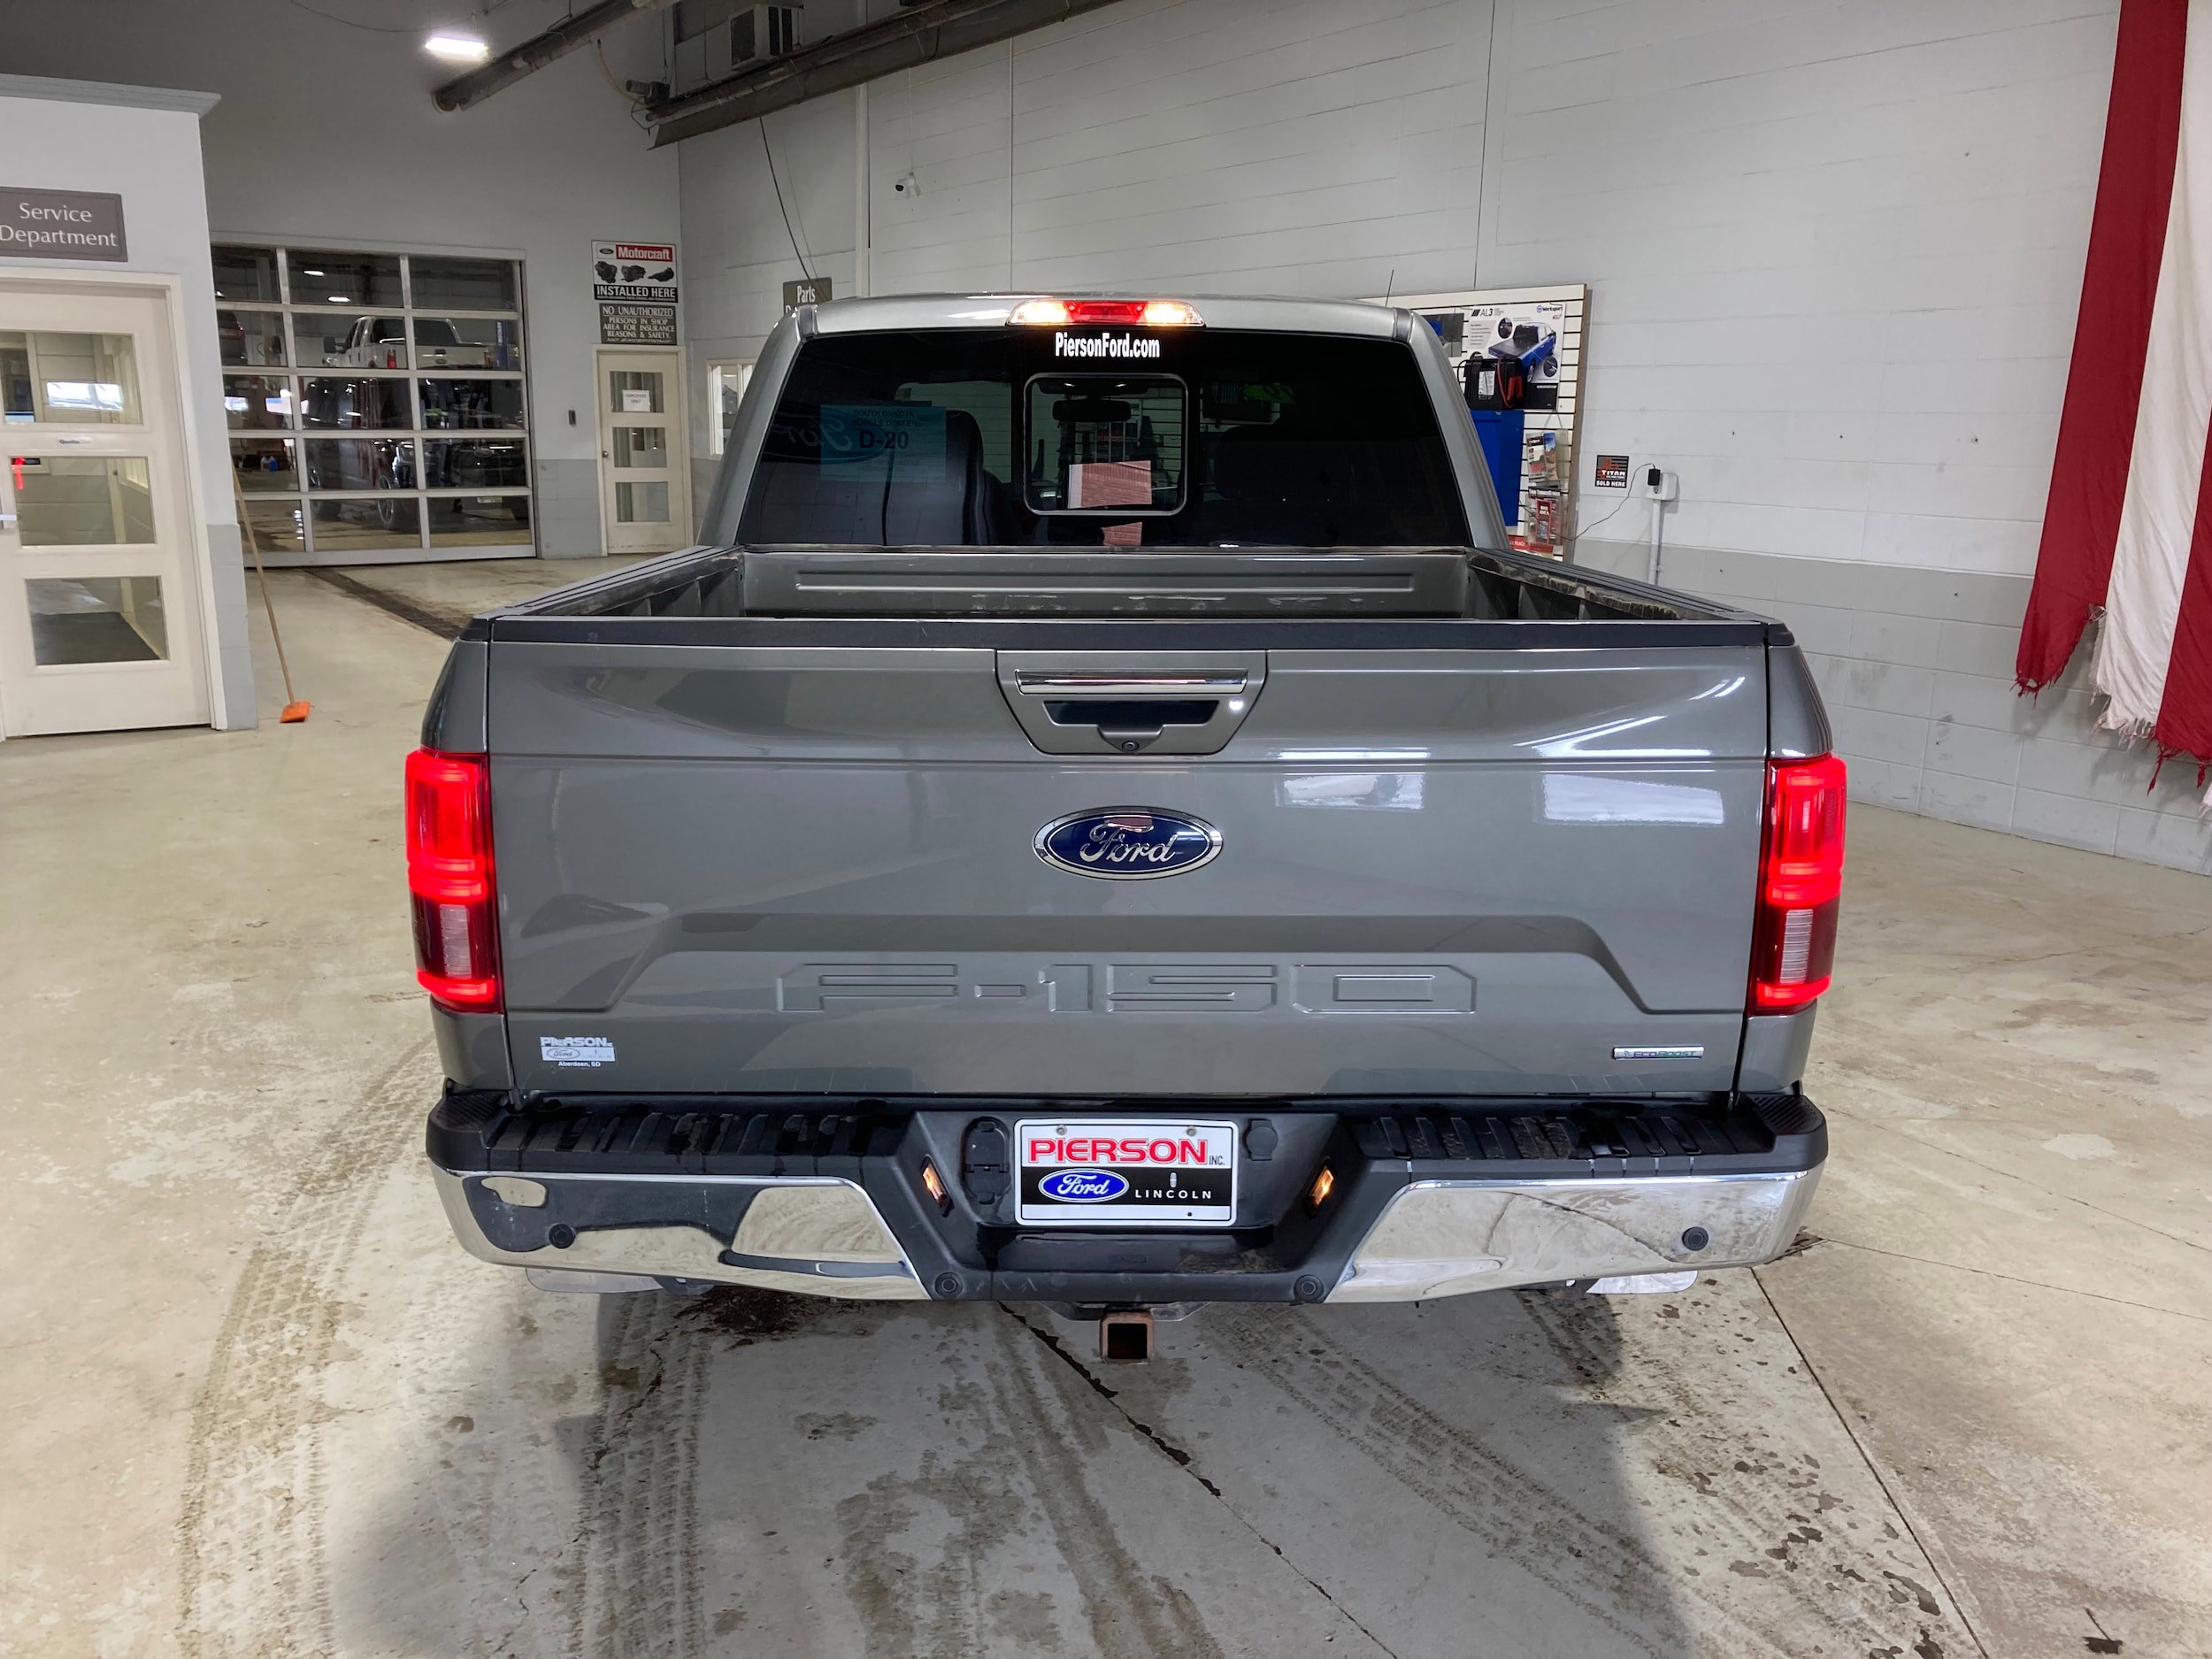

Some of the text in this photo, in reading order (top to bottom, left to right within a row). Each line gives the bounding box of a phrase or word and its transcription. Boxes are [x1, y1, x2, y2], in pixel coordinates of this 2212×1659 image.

[19, 203, 92, 222] Service
[0, 225, 118, 248] Department
[618, 247, 671, 260] Motorcraft
[596, 285, 649, 297] INSTALLED
[651, 288, 676, 298] HERE
[796, 285, 816, 303] Parts
[602, 305, 673, 317] NO UNAUTHORIZED
[1055, 332, 1161, 358] PiersonFord.com
[859, 429, 910, 449] D-20
[1079, 821, 1179, 863] Ford
[776, 962, 1479, 1014] F-150
[540, 1036, 608, 1047] PIERSON
[1027, 1137, 1225, 1166] PIERSON INC.
[1056, 1171, 1110, 1195] Ford
[1135, 1189, 1212, 1200] LINCOLN
